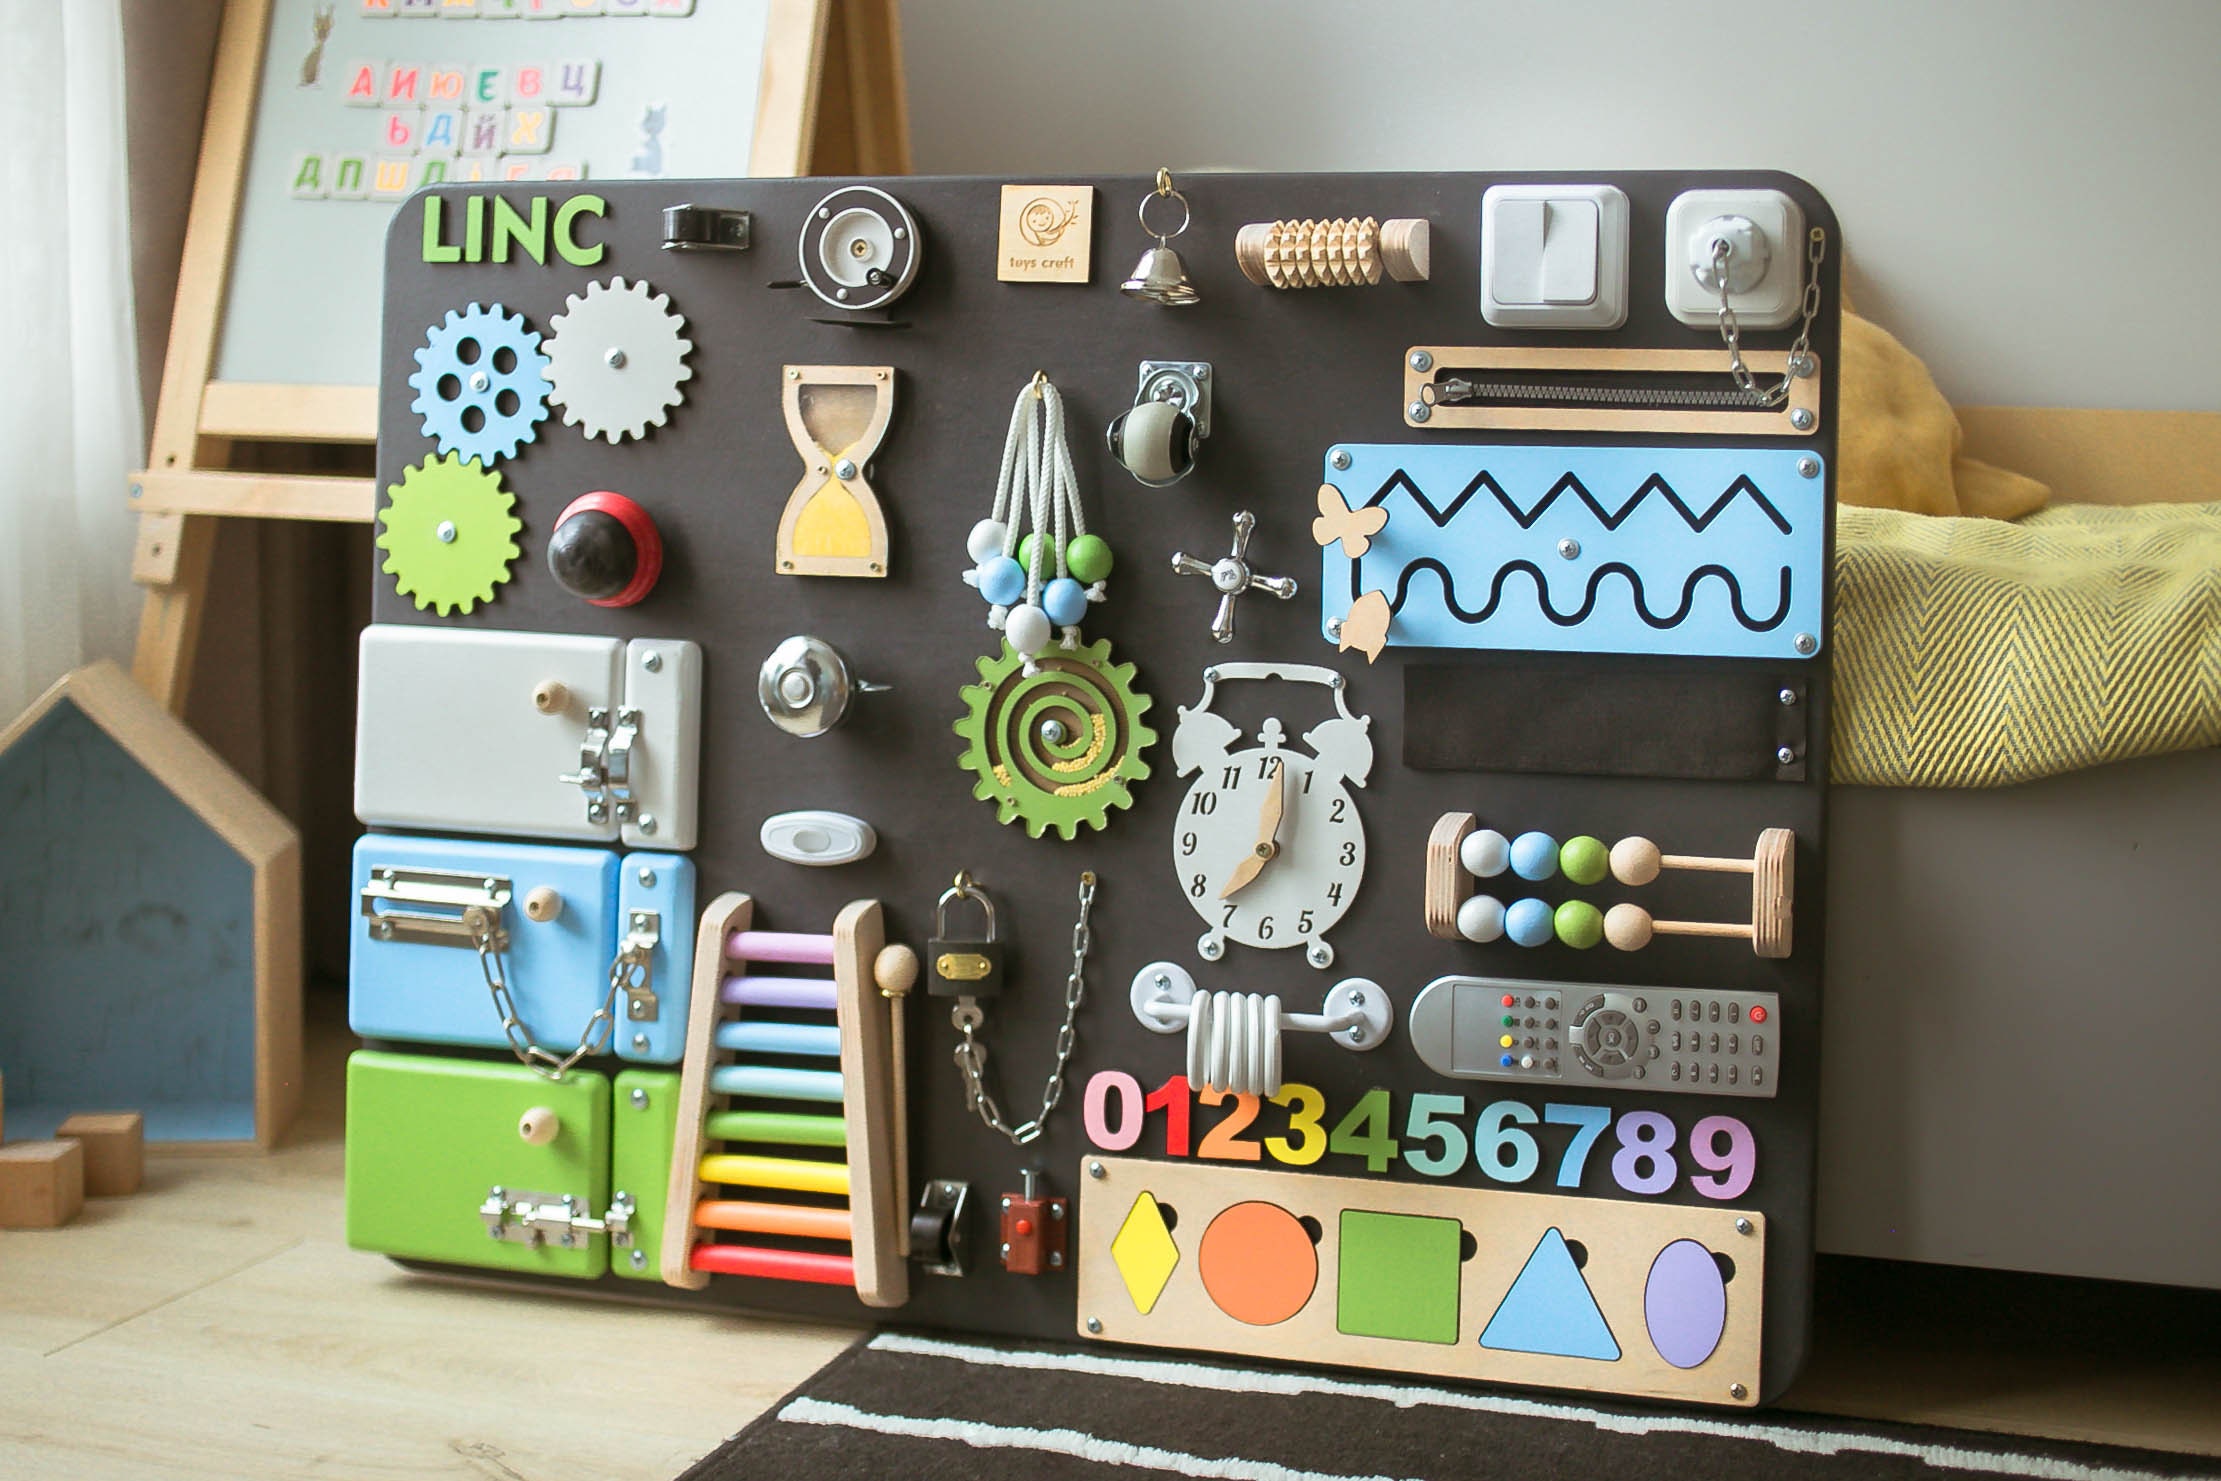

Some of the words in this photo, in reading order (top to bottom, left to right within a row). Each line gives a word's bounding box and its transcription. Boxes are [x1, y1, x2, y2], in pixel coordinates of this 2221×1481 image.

[422, 193, 607, 267] LINC
[1009, 257, 1037, 271] toys
[1041, 256, 1074, 269] craft
[1222, 766, 1241, 790] 11
[1303, 770, 1313, 794] 1
[1191, 791, 1217, 815] 10
[1329, 799, 1345, 823] 2
[1182, 832, 1197, 856] 9
[1340, 842, 1355, 866] 3
[1191, 874, 1206, 898] 8
[1327, 882, 1343, 907] 4
[1222, 904, 1237, 928] 7
[1258, 916, 1274, 940] 6
[1298, 910, 1313, 933] 5
